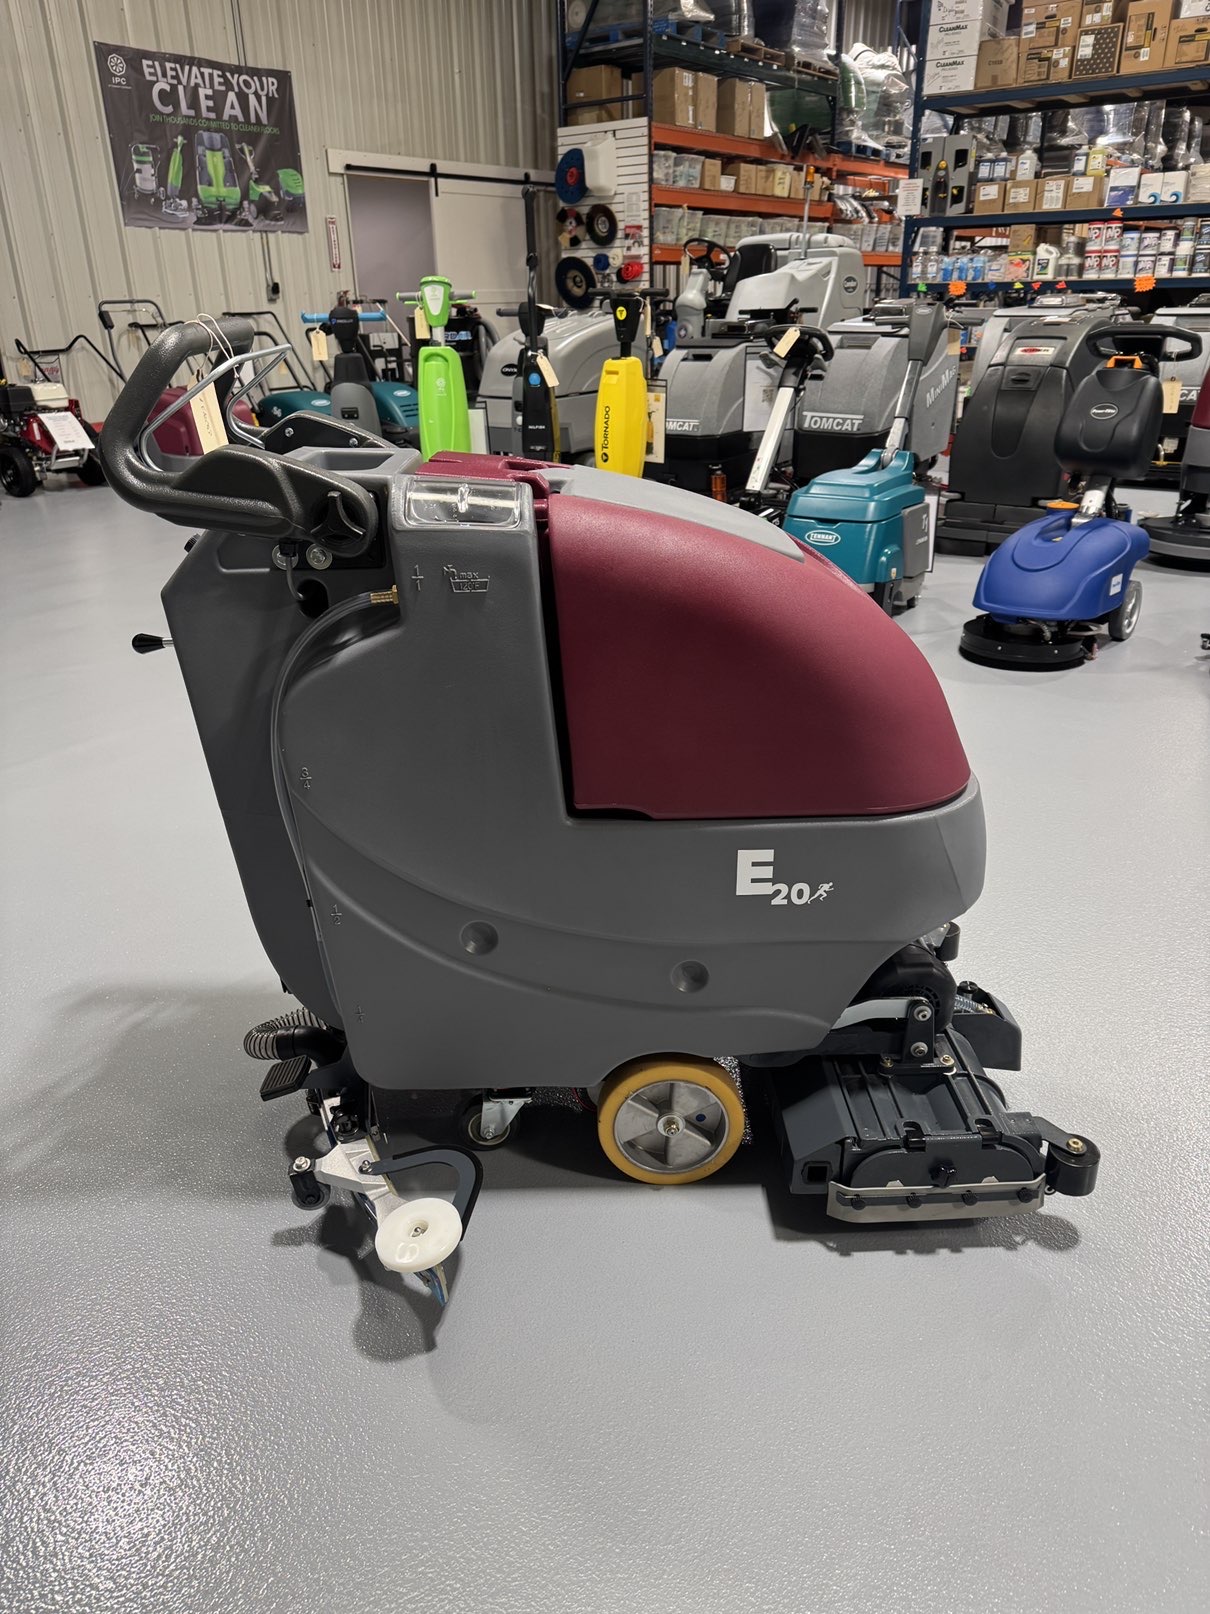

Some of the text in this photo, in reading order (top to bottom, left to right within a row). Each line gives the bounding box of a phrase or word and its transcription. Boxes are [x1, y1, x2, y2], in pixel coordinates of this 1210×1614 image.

[111, 76, 127, 85] IPC
[142, 59, 279, 98] ELEVATE YOUR
[152, 81, 268, 125] CLEAN
[149, 113, 163, 123] JOIN
[230, 122, 239, 131] TO
[601, 405, 611, 451] TORNADO
[802, 411, 864, 431] TOMCAT
[809, 532, 838, 544] TENNANT
[460, 571, 479, 579] max
